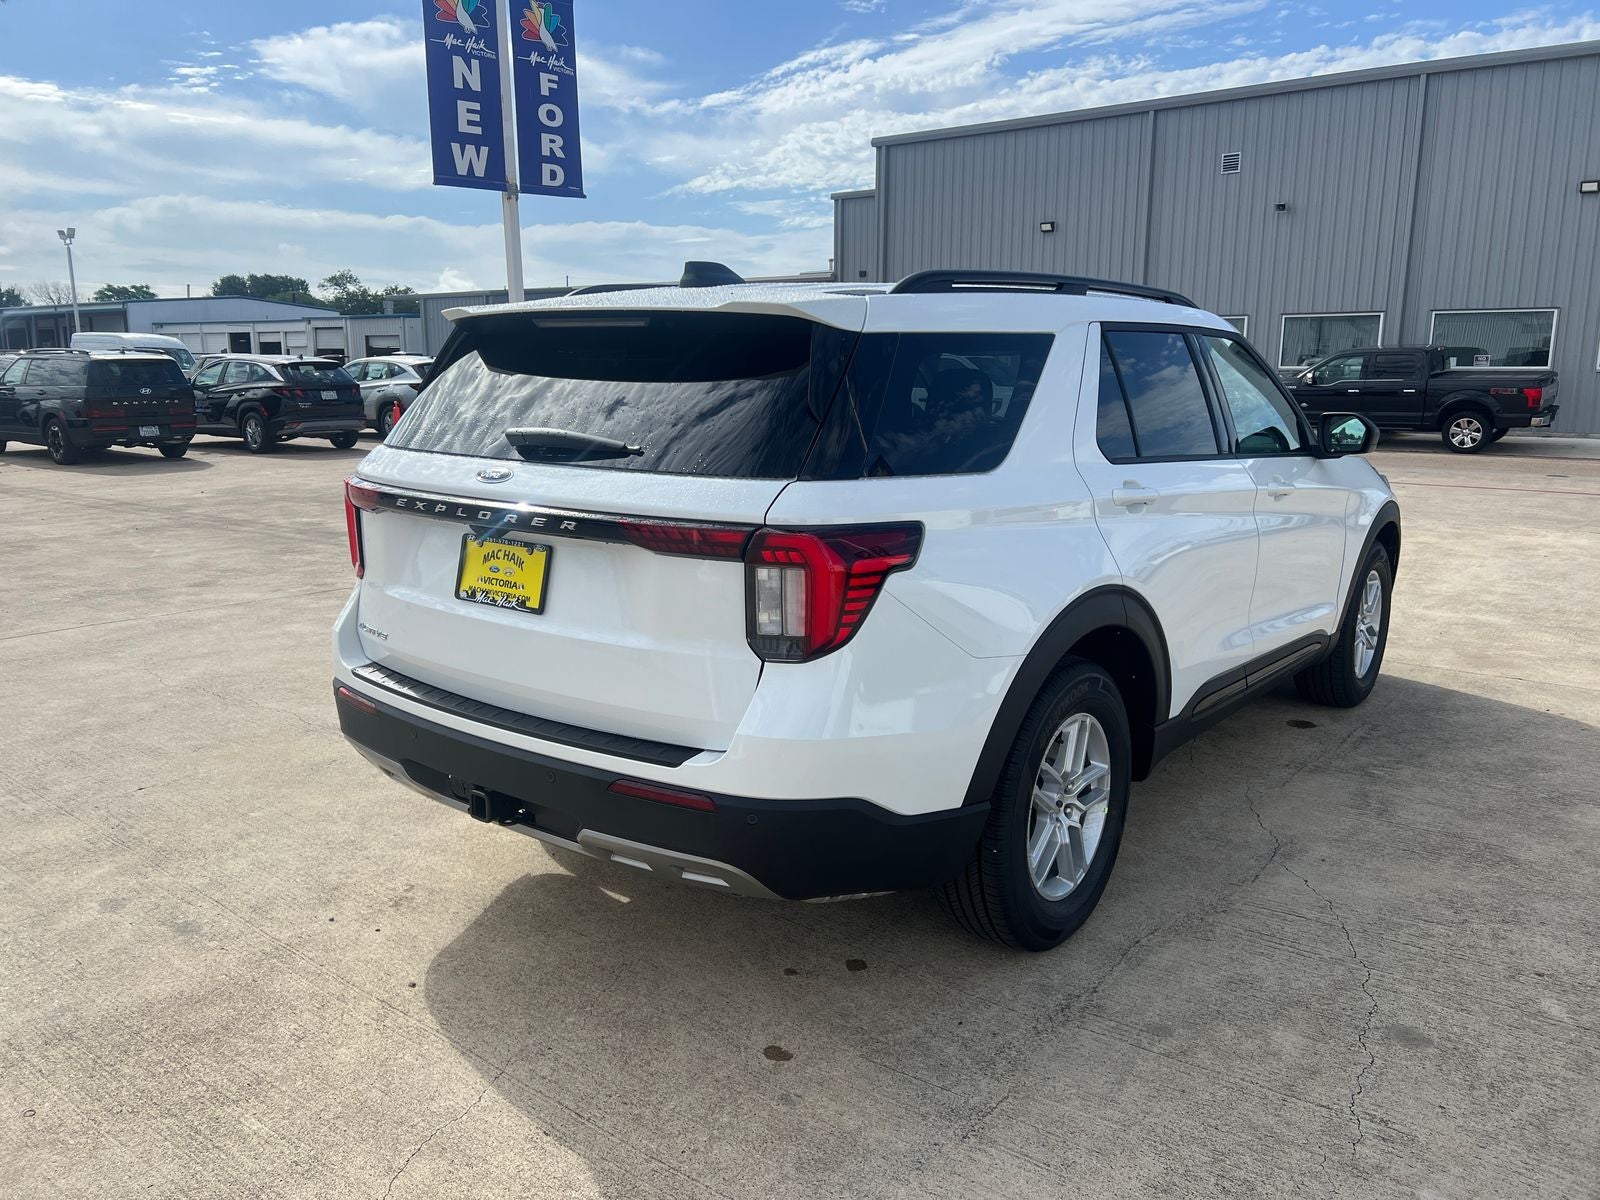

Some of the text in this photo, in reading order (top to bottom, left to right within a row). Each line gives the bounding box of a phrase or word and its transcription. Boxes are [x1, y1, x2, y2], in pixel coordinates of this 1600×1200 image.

[437, 33, 494, 54] Mac Haik
[471, 50, 497, 60] VICTORIA
[552, 66, 575, 76] VICTORIA
[450, 55, 489, 178] NEW
[537, 71, 566, 187] FORD
[396, 498, 577, 531] EXPLORER
[482, 549, 525, 572] MAC HAIK
[483, 576, 518, 590] VICTORIA
[471, 591, 525, 610] Mac Haik
